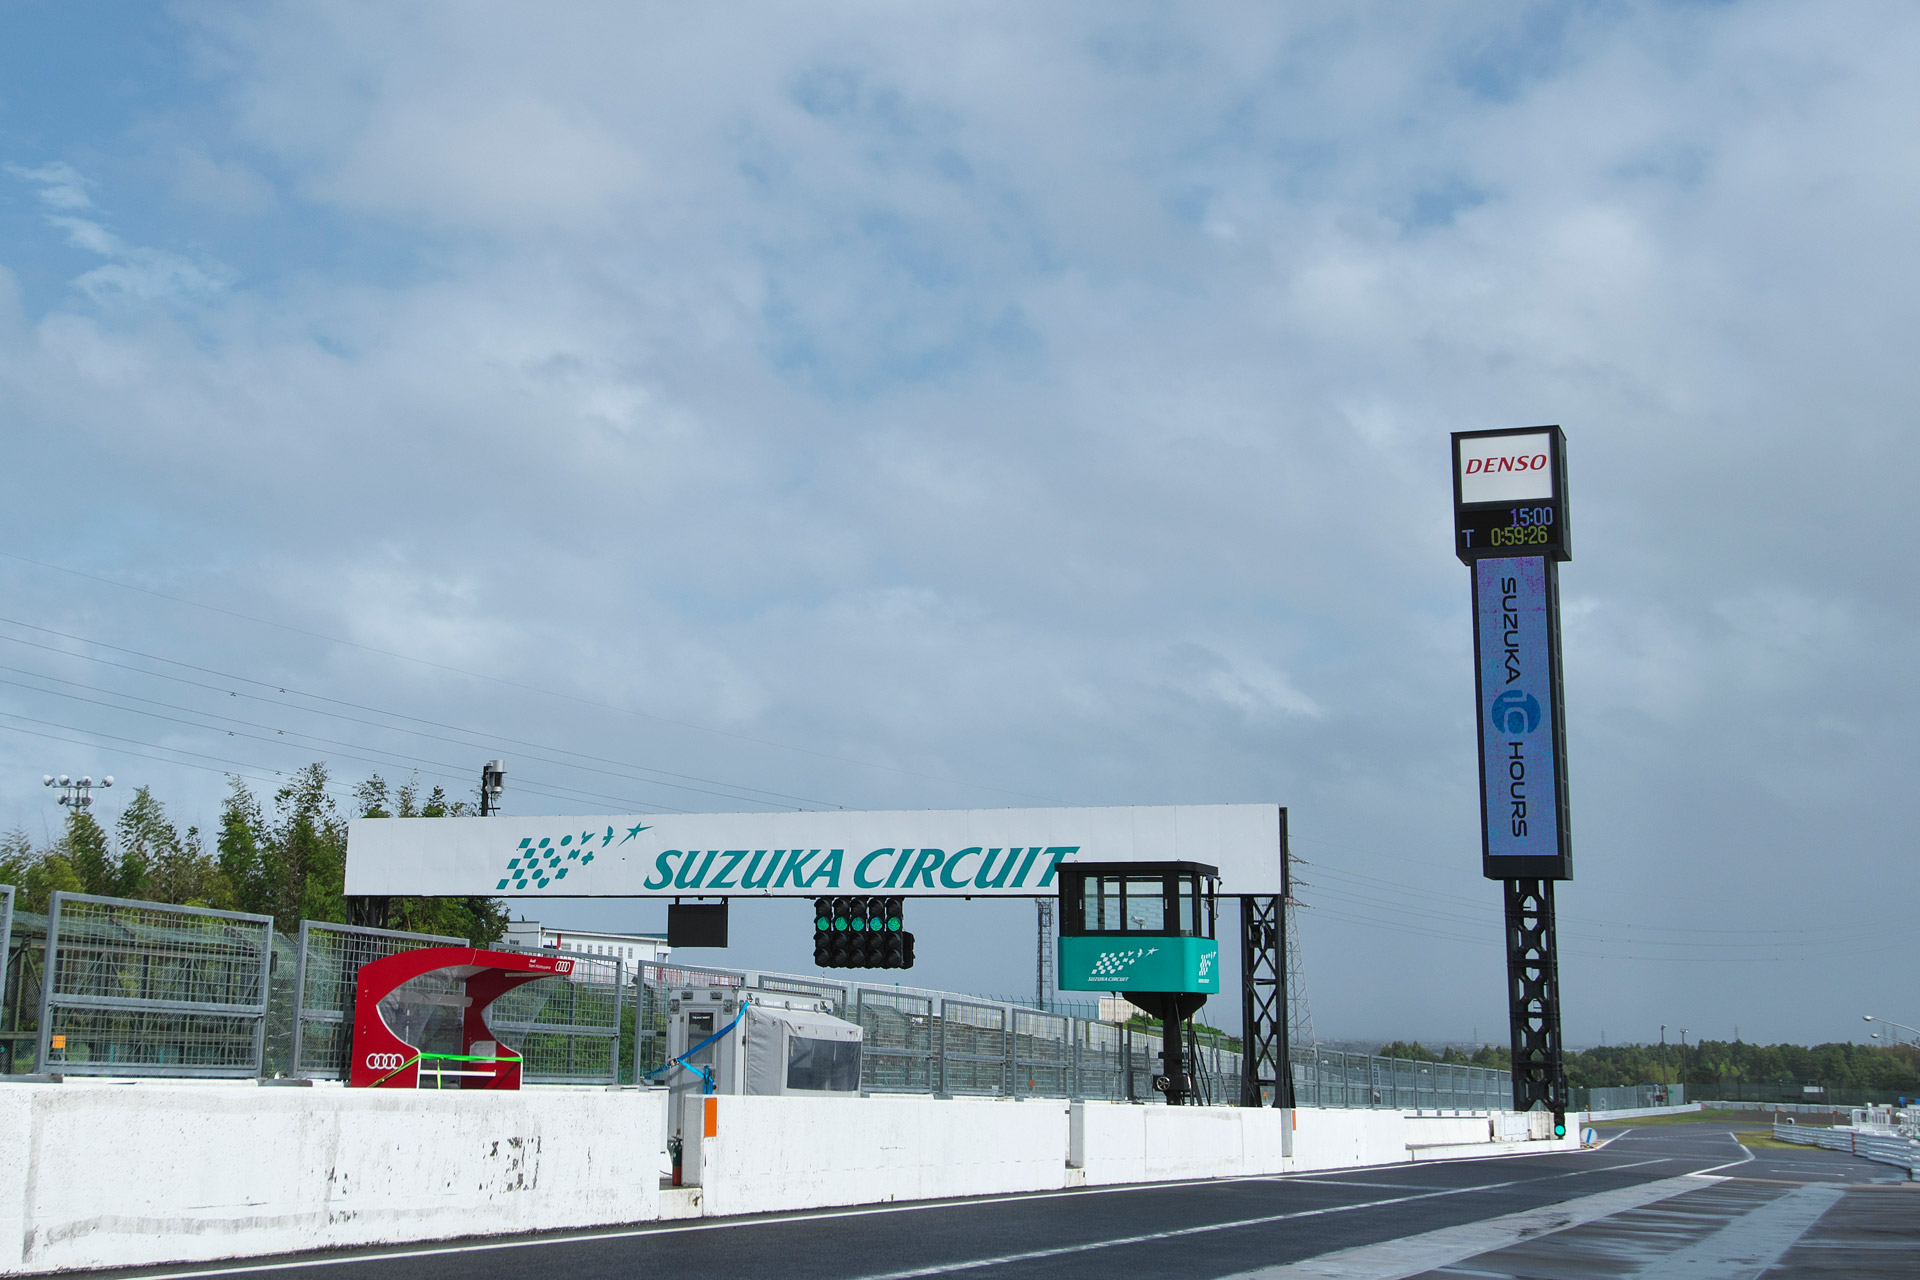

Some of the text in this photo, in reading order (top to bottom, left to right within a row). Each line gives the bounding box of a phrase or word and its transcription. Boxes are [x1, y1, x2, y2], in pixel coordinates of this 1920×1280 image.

[1465, 454, 1547, 474] DENSO
[1510, 507, 1553, 527] 15:00
[1461, 525, 1548, 548] T 0:59:26
[1501, 577, 1521, 685] SUZUKA
[1508, 741, 1528, 838] HOURS
[643, 845, 1081, 890] SUZUKA CIRCUIT
